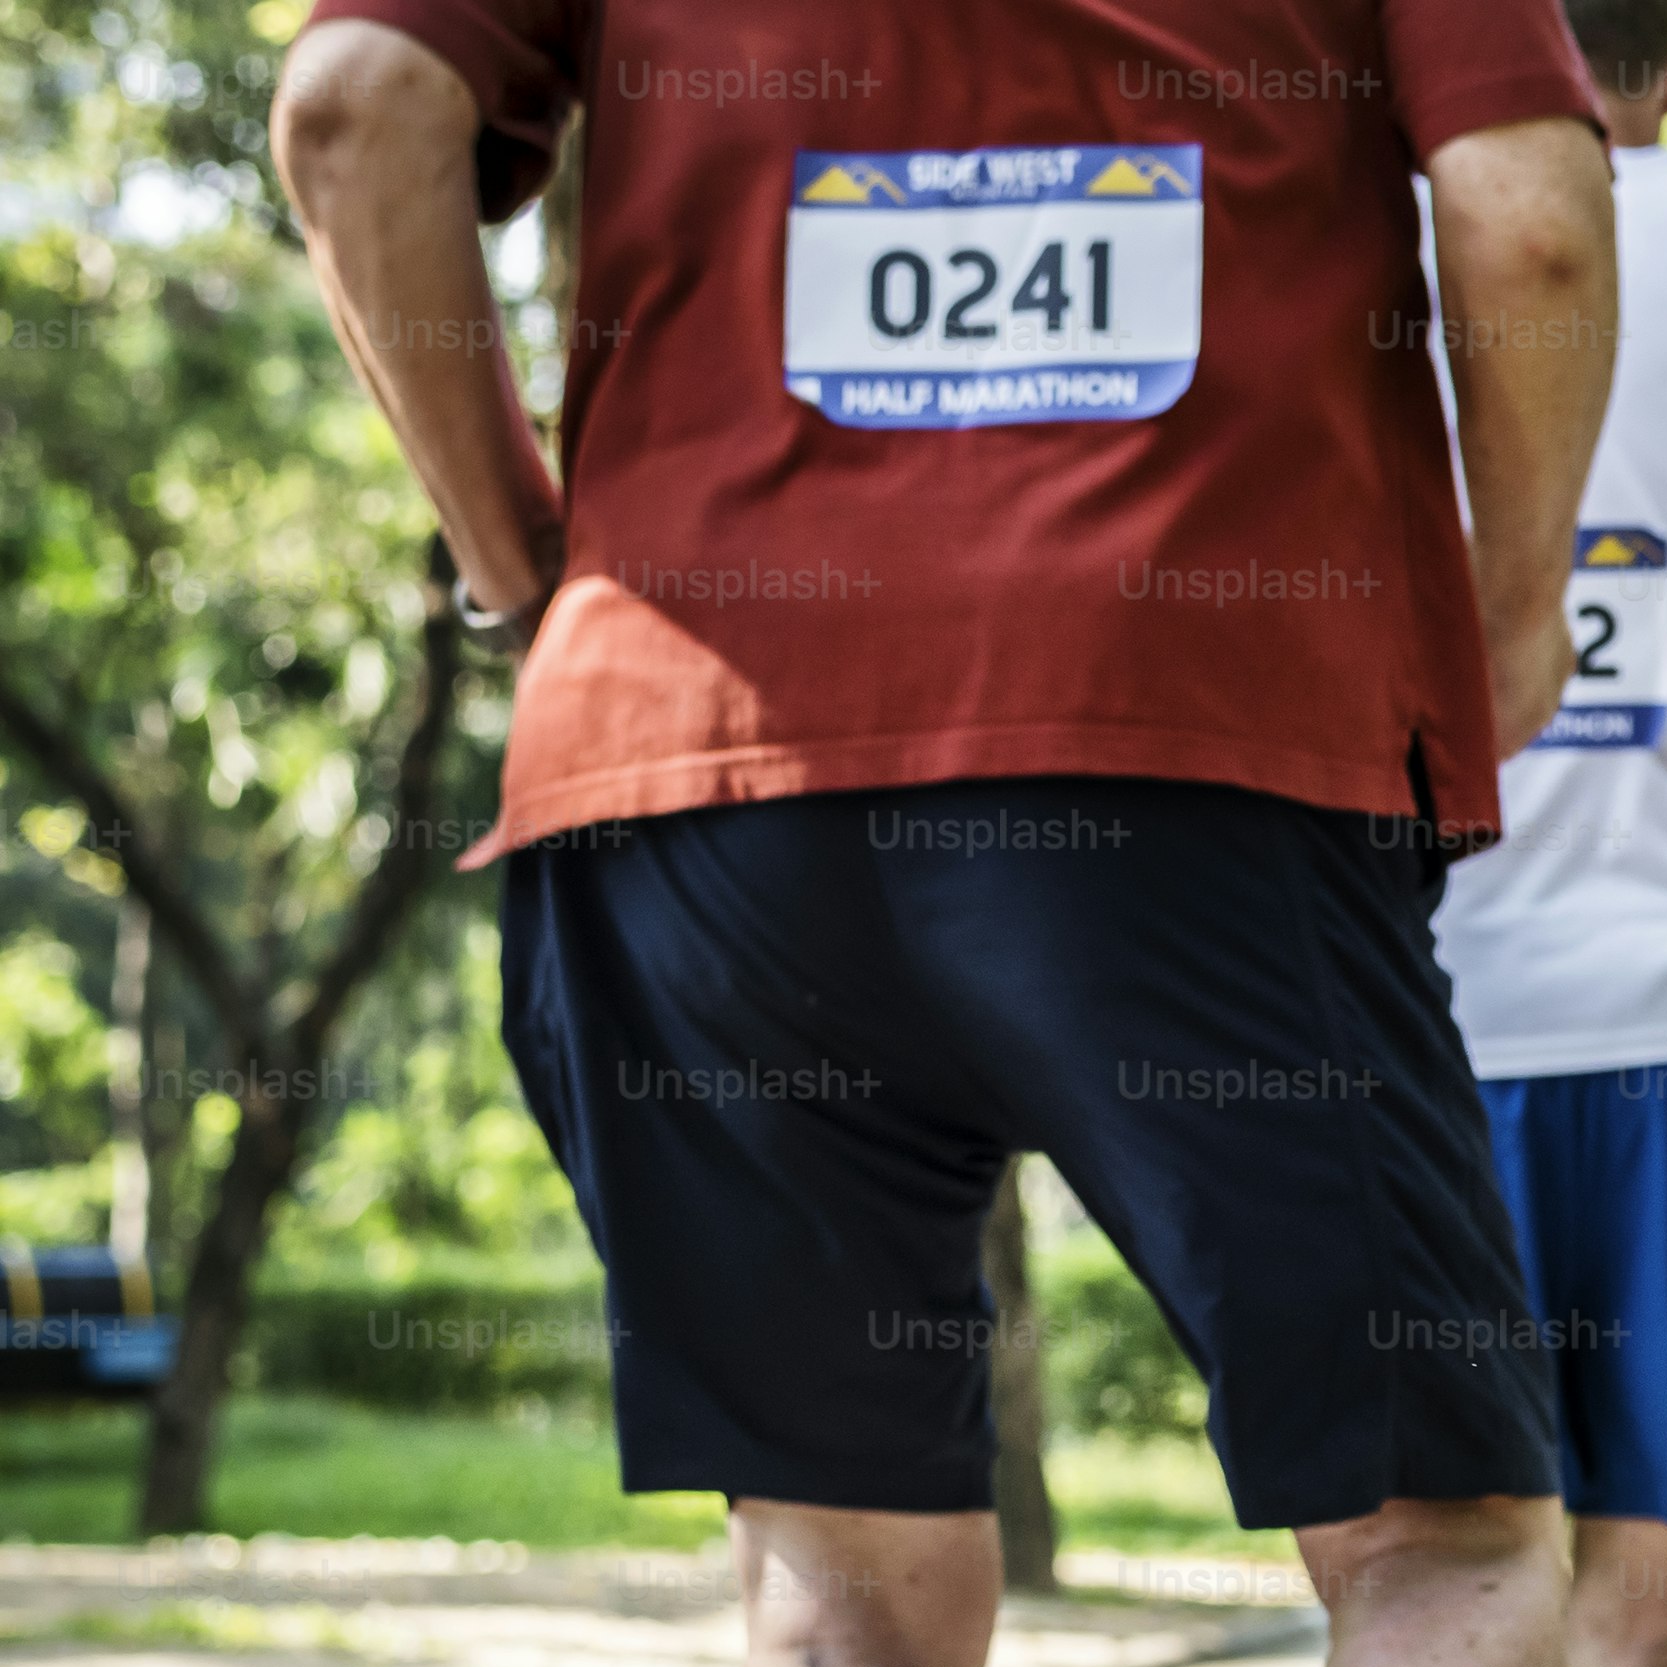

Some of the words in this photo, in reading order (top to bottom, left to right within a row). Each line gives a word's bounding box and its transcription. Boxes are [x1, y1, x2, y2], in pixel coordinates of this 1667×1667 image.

[907, 153, 979, 192] SIDE
[986, 149, 1081, 187] WEST
[871, 240, 1110, 339] 0241
[841, 378, 932, 416] HALF
[938, 373, 1138, 415] MARATHON
[1577, 604, 1619, 677] 2
